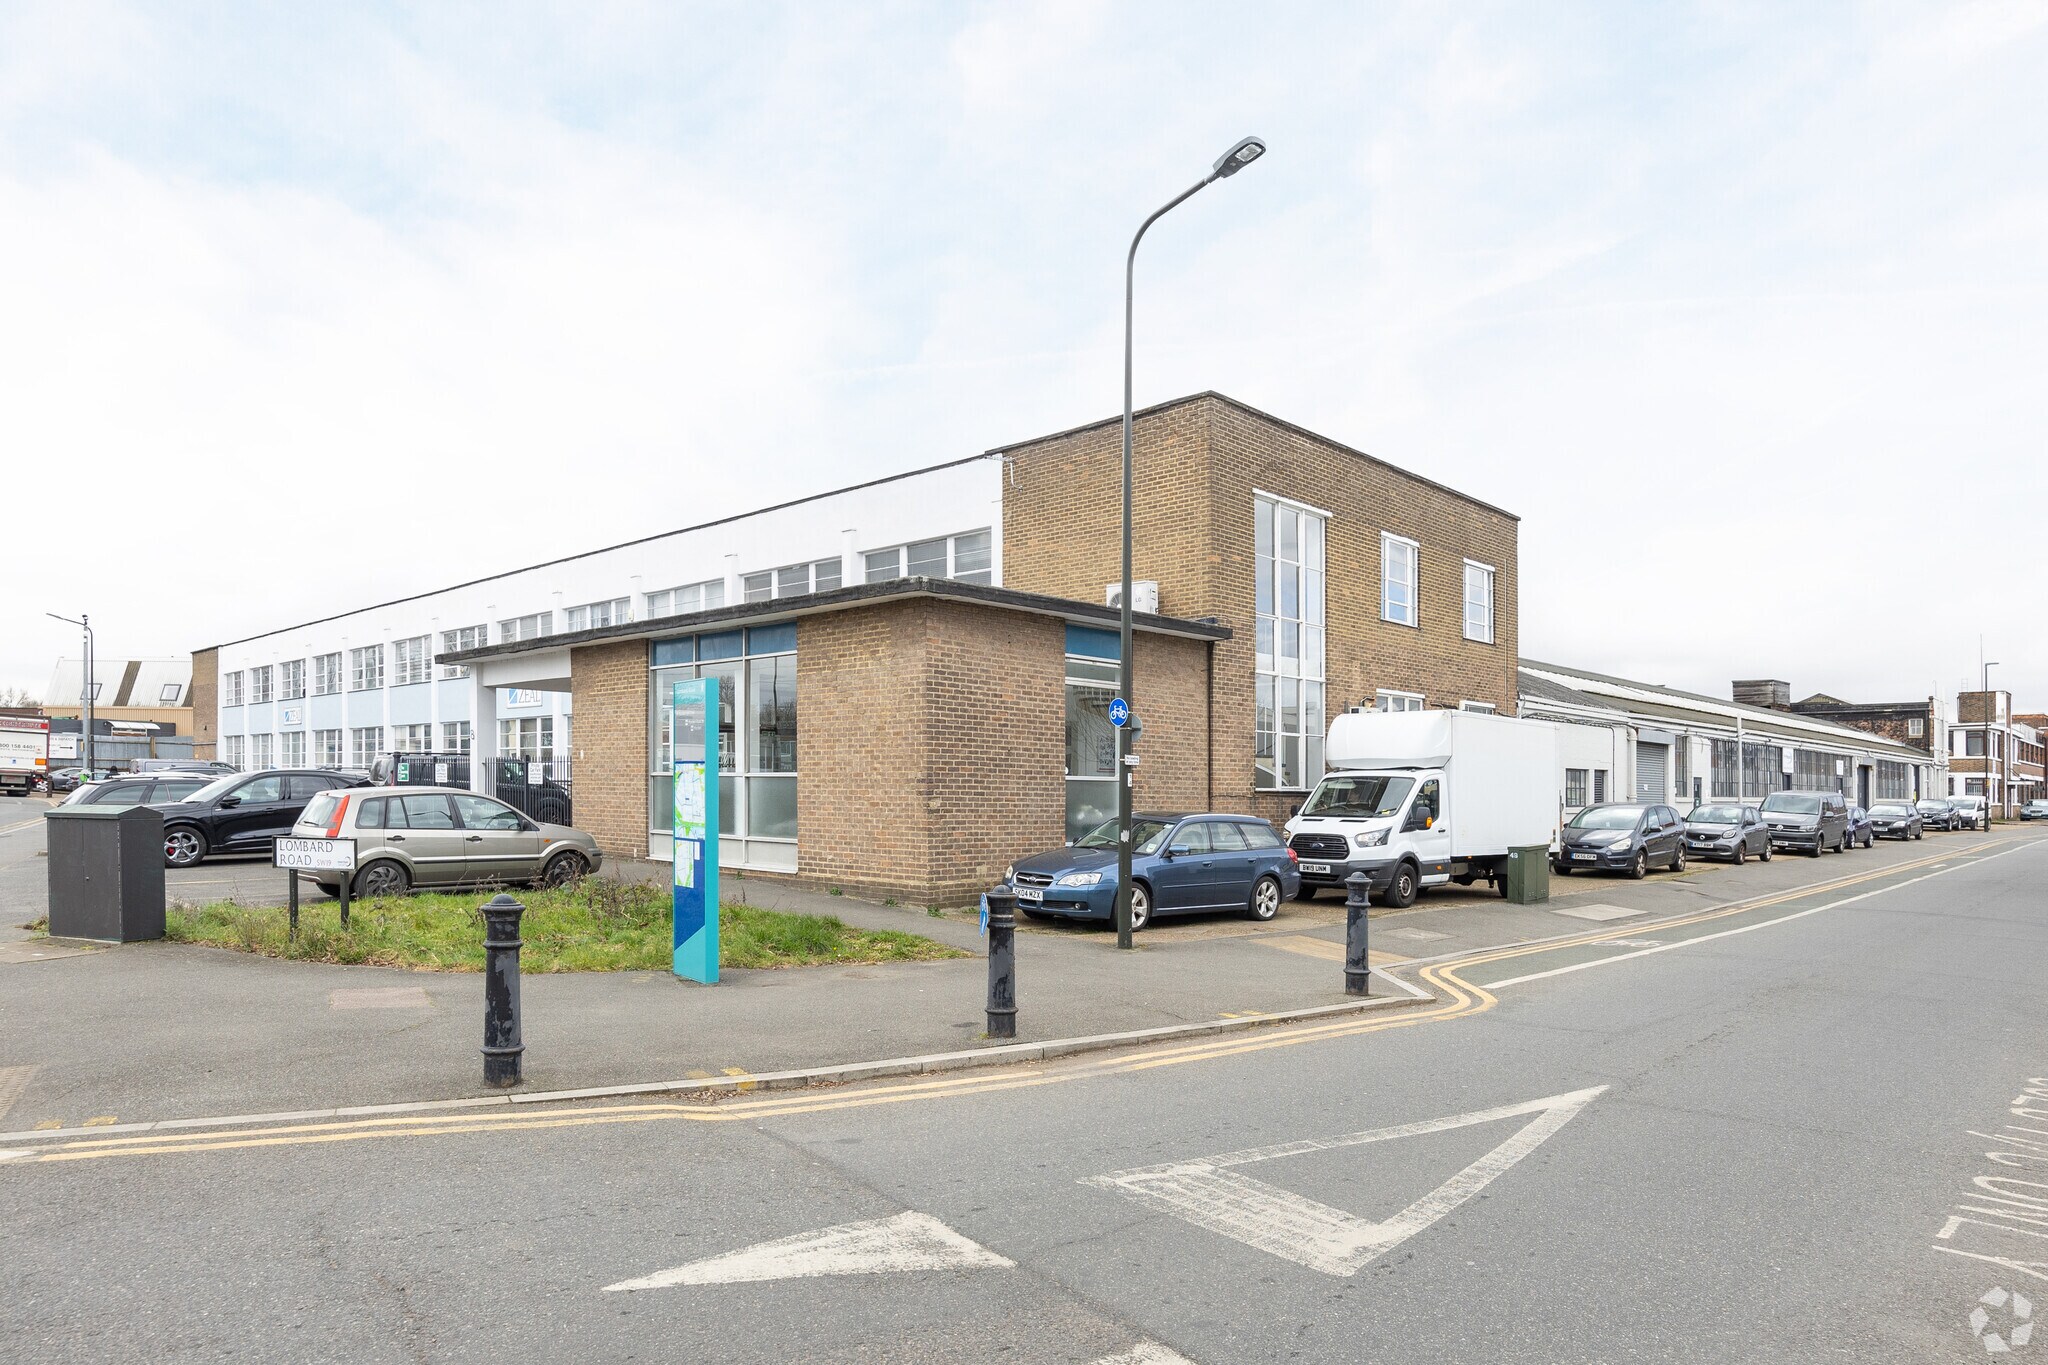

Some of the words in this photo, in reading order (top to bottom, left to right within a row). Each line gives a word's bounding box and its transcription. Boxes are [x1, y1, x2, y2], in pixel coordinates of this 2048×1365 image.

[518, 689, 541, 703] ZEAL
[279, 840, 334, 853] LOMBARD
[280, 854, 312, 866] ROAD
[316, 858, 332, 867] SW19
